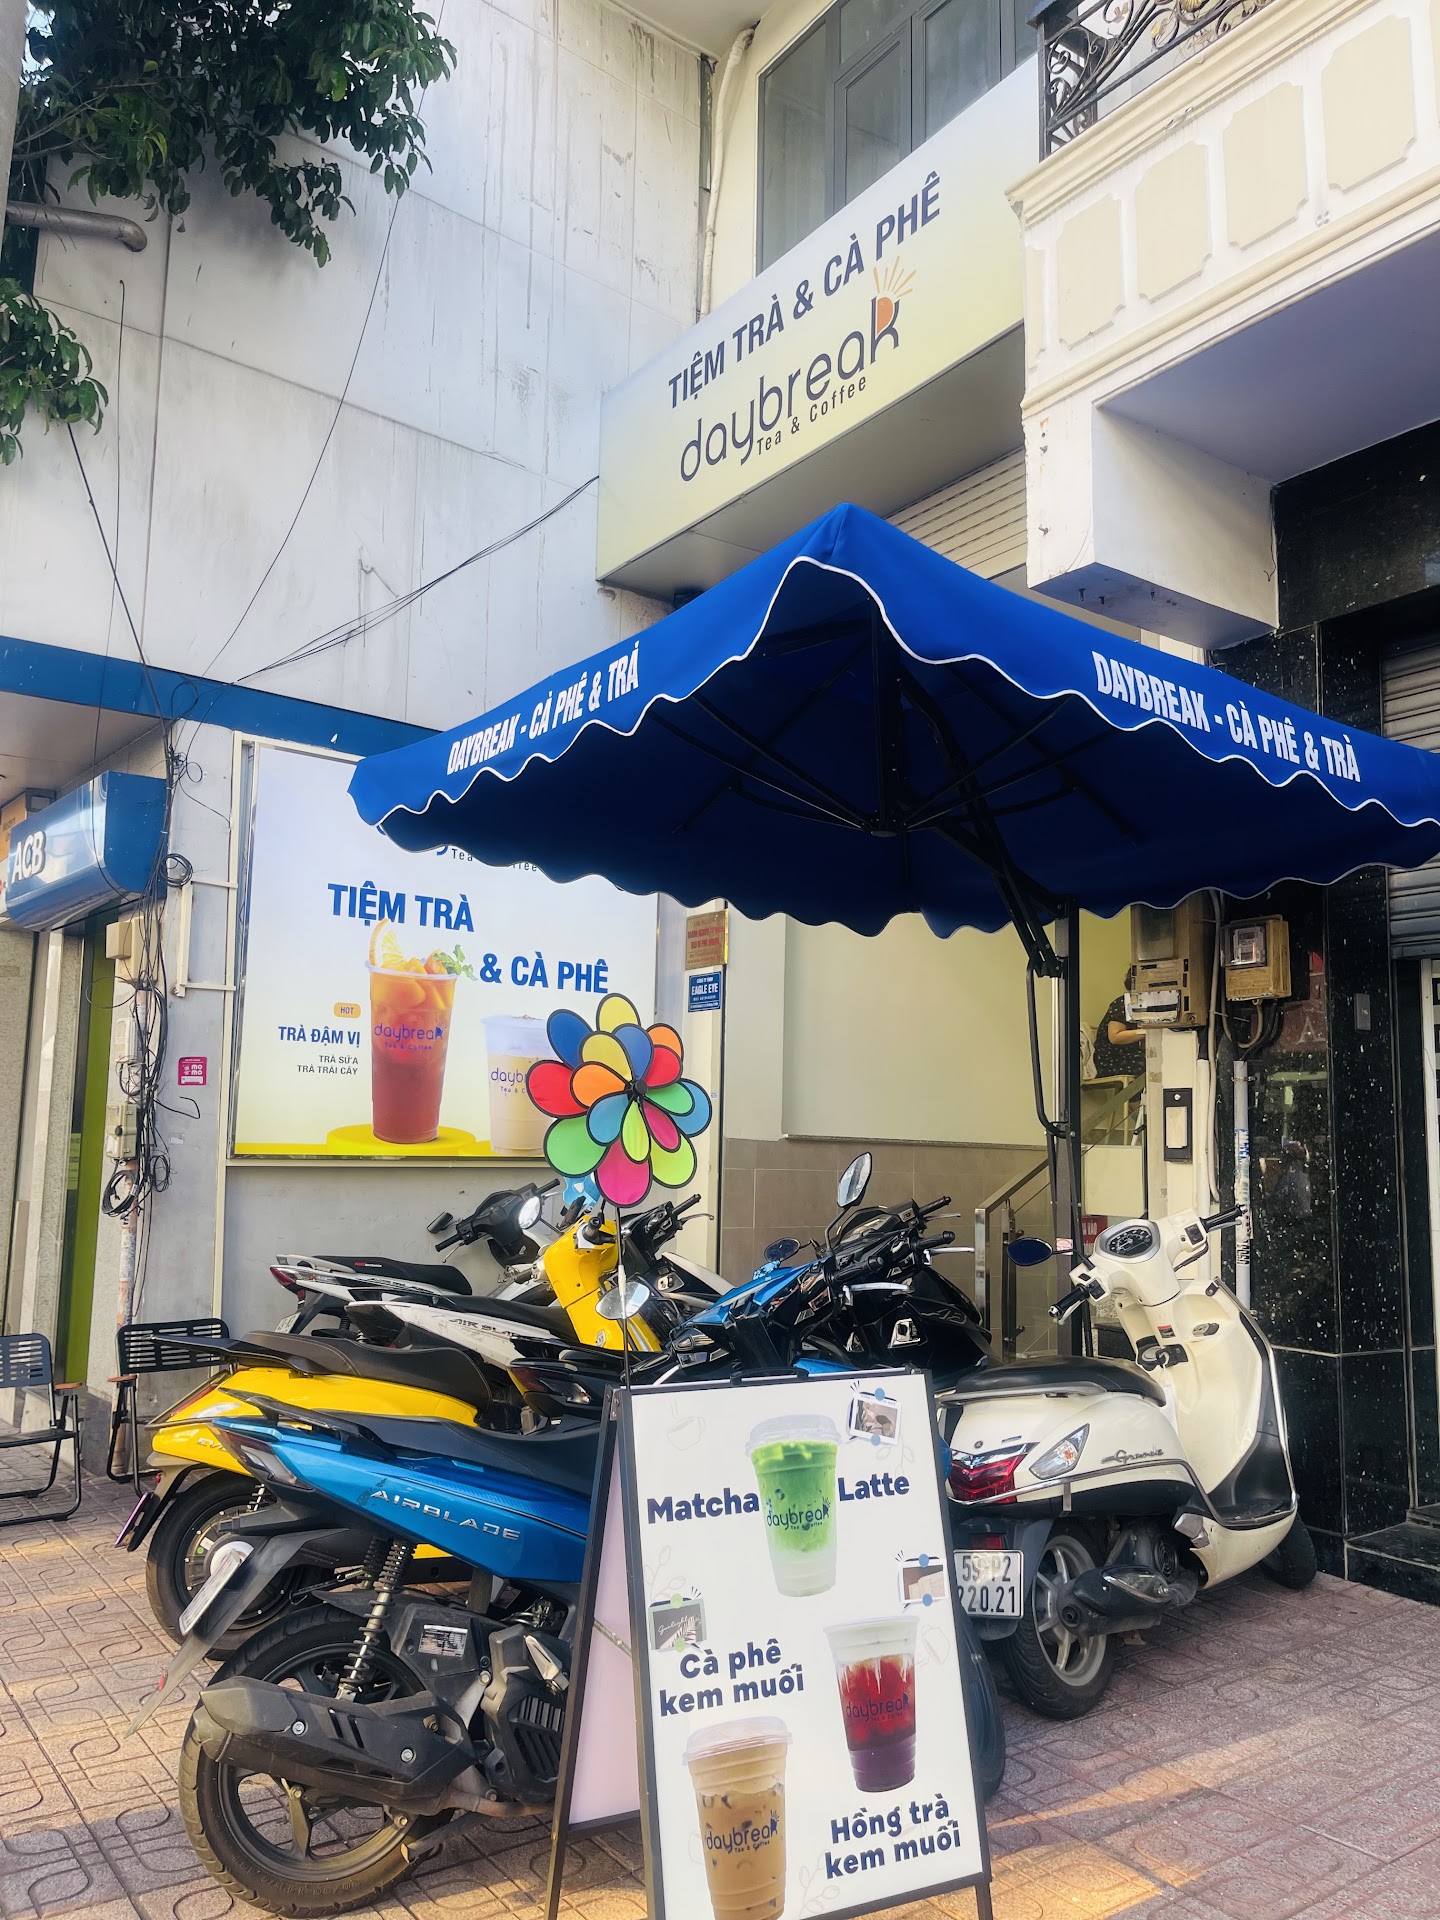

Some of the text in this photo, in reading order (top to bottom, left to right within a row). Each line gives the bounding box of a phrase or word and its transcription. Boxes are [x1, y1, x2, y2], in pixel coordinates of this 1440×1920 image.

[668, 170, 941, 409] TIỆM TRÀ & CÀ PHÊ
[680, 295, 901, 482] daybreak
[756, 376, 867, 456] Tea & Coffee
[446, 713, 522, 776] DAYBREAK
[551, 671, 588, 730] PHÊ
[588, 670, 602, 712] &
[1091, 650, 1211, 733] DAYBREAK
[1225, 700, 1259, 750] CÀ
[1257, 716, 1301, 765] PHÊ
[1303, 731, 1321, 771] &
[1320, 733, 1361, 783] TRÀ
[11, 830, 46, 884] ACB
[327, 880, 475, 933] TIỆM TRÀ
[479, 951, 609, 994] & CÀ PHÊ
[278, 1024, 361, 1048] TRÀ ĐẬM VỊ
[340, 1006, 355, 1015] HOT
[374, 1022, 444, 1042] daybreak
[297, 1064, 315, 1073] TRÀ
[319, 1054, 336, 1063] TRÀ
[491, 1067, 526, 1087] dayb
[370, 1490, 521, 1541] AIRBLADE
[648, 1472, 911, 1524] Matcha Latte
[767, 1503, 829, 1531] daybreak
[679, 1638, 783, 1679] Cà phê
[659, 1663, 805, 1717] kem muối
[706, 1817, 778, 1855] daybreak
[830, 1793, 950, 1844] Hồng trà
[825, 1820, 962, 1879] kem muối
